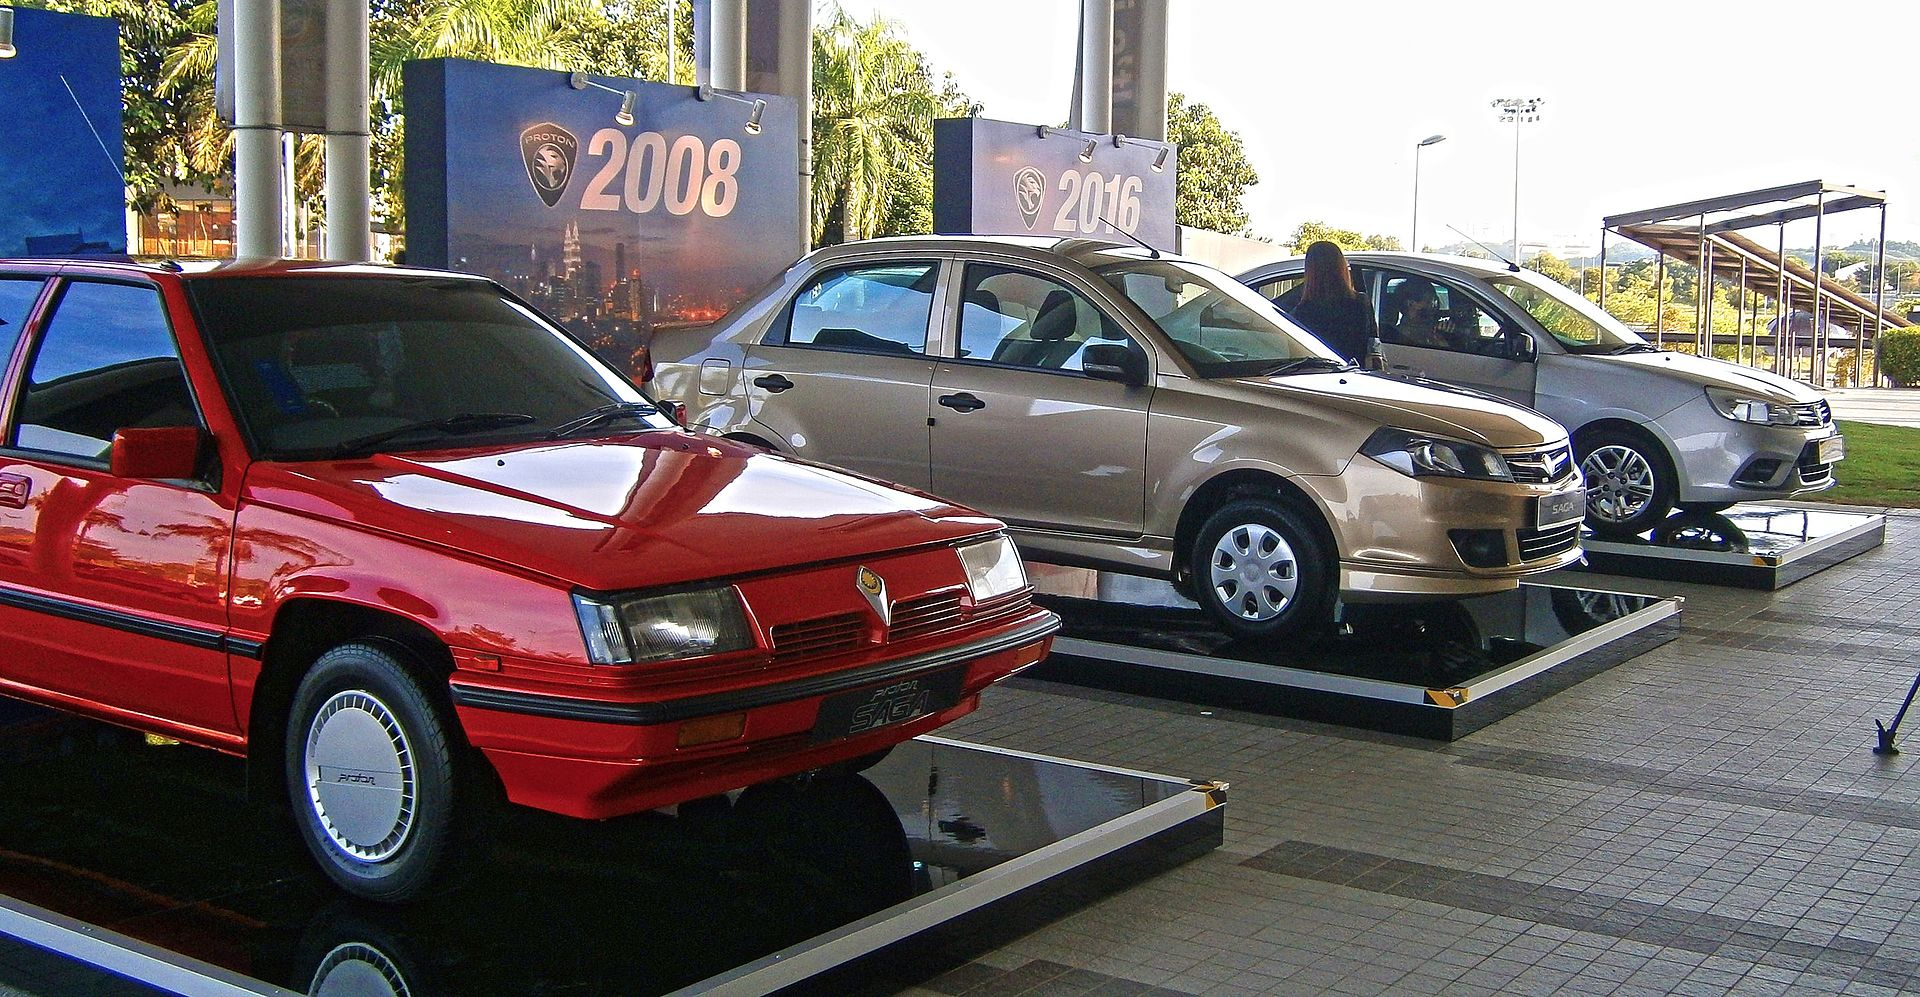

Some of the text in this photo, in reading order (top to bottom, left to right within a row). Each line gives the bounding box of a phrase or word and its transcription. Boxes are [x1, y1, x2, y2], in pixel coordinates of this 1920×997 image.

[525, 133, 576, 148] PROTON
[579, 127, 742, 218] 2008
[1053, 169, 1143, 236] 2016
[1551, 501, 1575, 515] SAGA
[849, 689, 930, 734] SAGA
